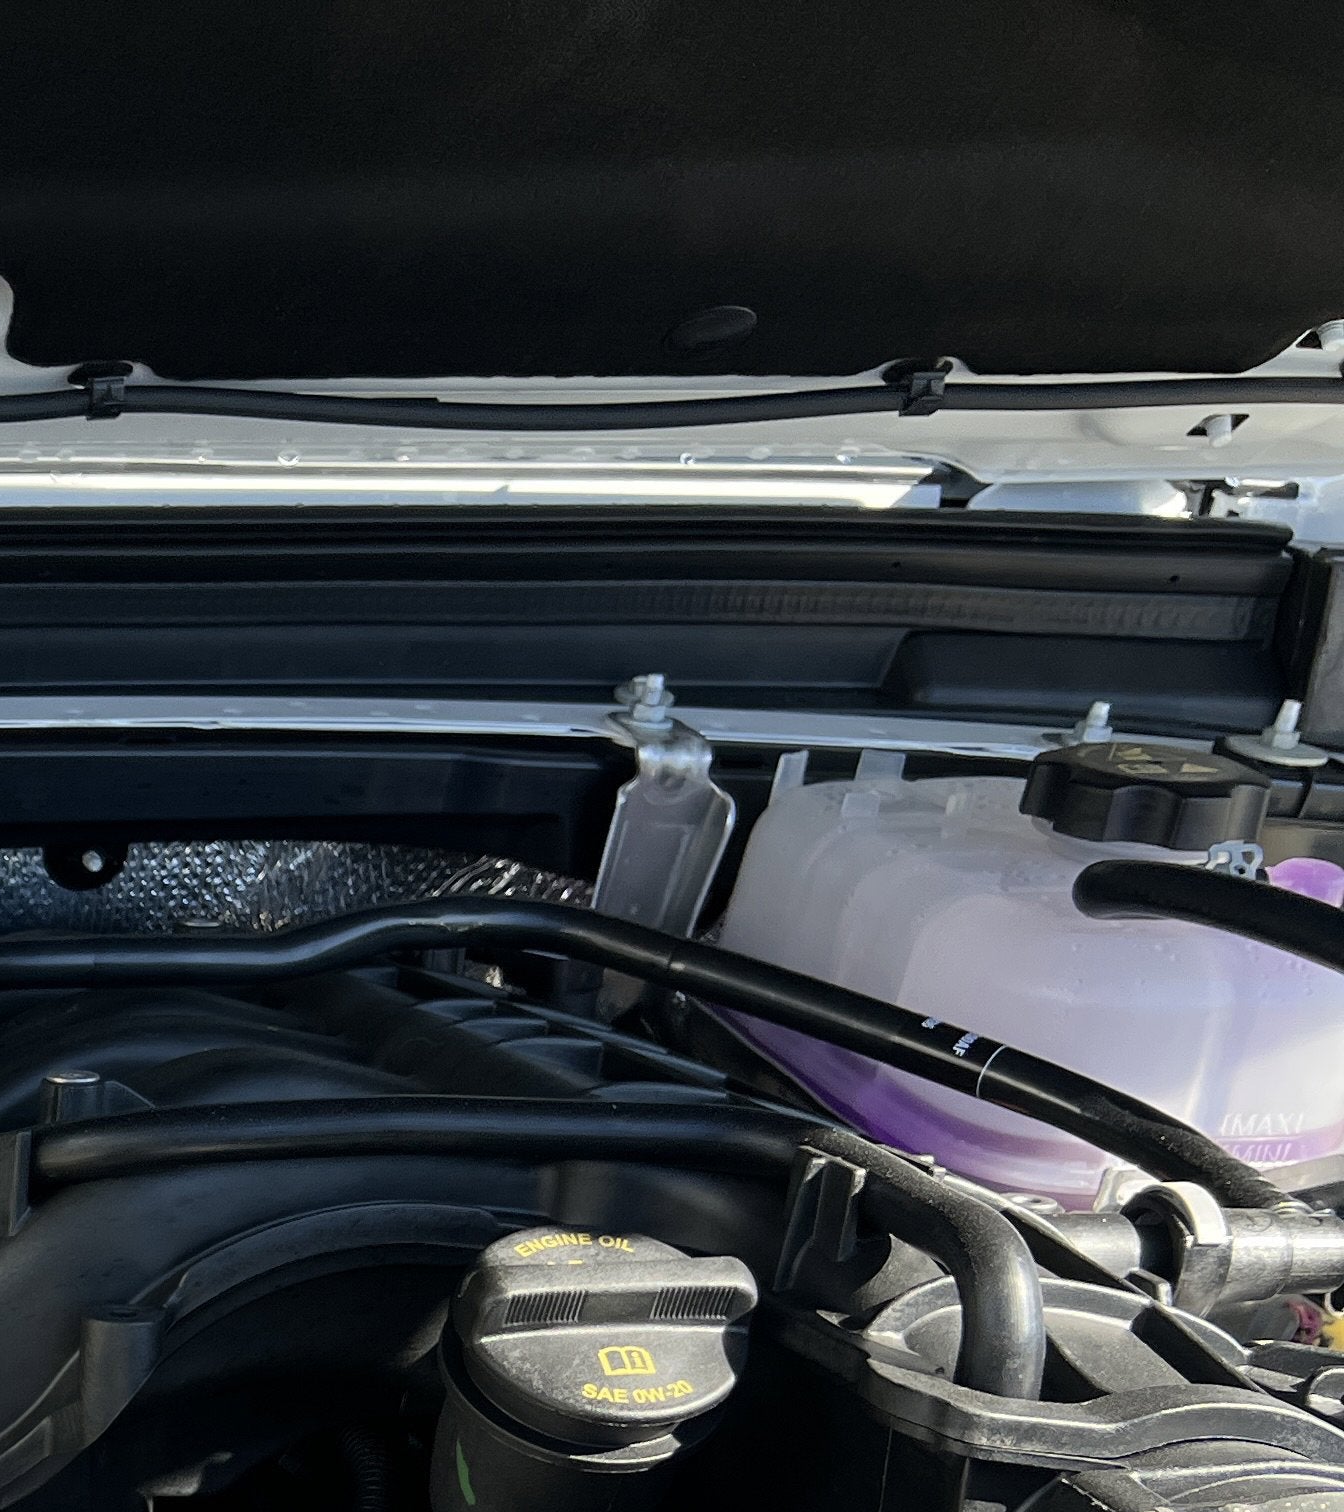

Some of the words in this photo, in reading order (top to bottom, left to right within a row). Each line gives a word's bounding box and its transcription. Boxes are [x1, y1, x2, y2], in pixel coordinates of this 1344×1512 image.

[514, 1233, 593, 1257] ENGINE
[598, 1235, 635, 1253] OIL
[581, 1383, 630, 1404] SAE
[632, 1379, 694, 1404] 0W-20
